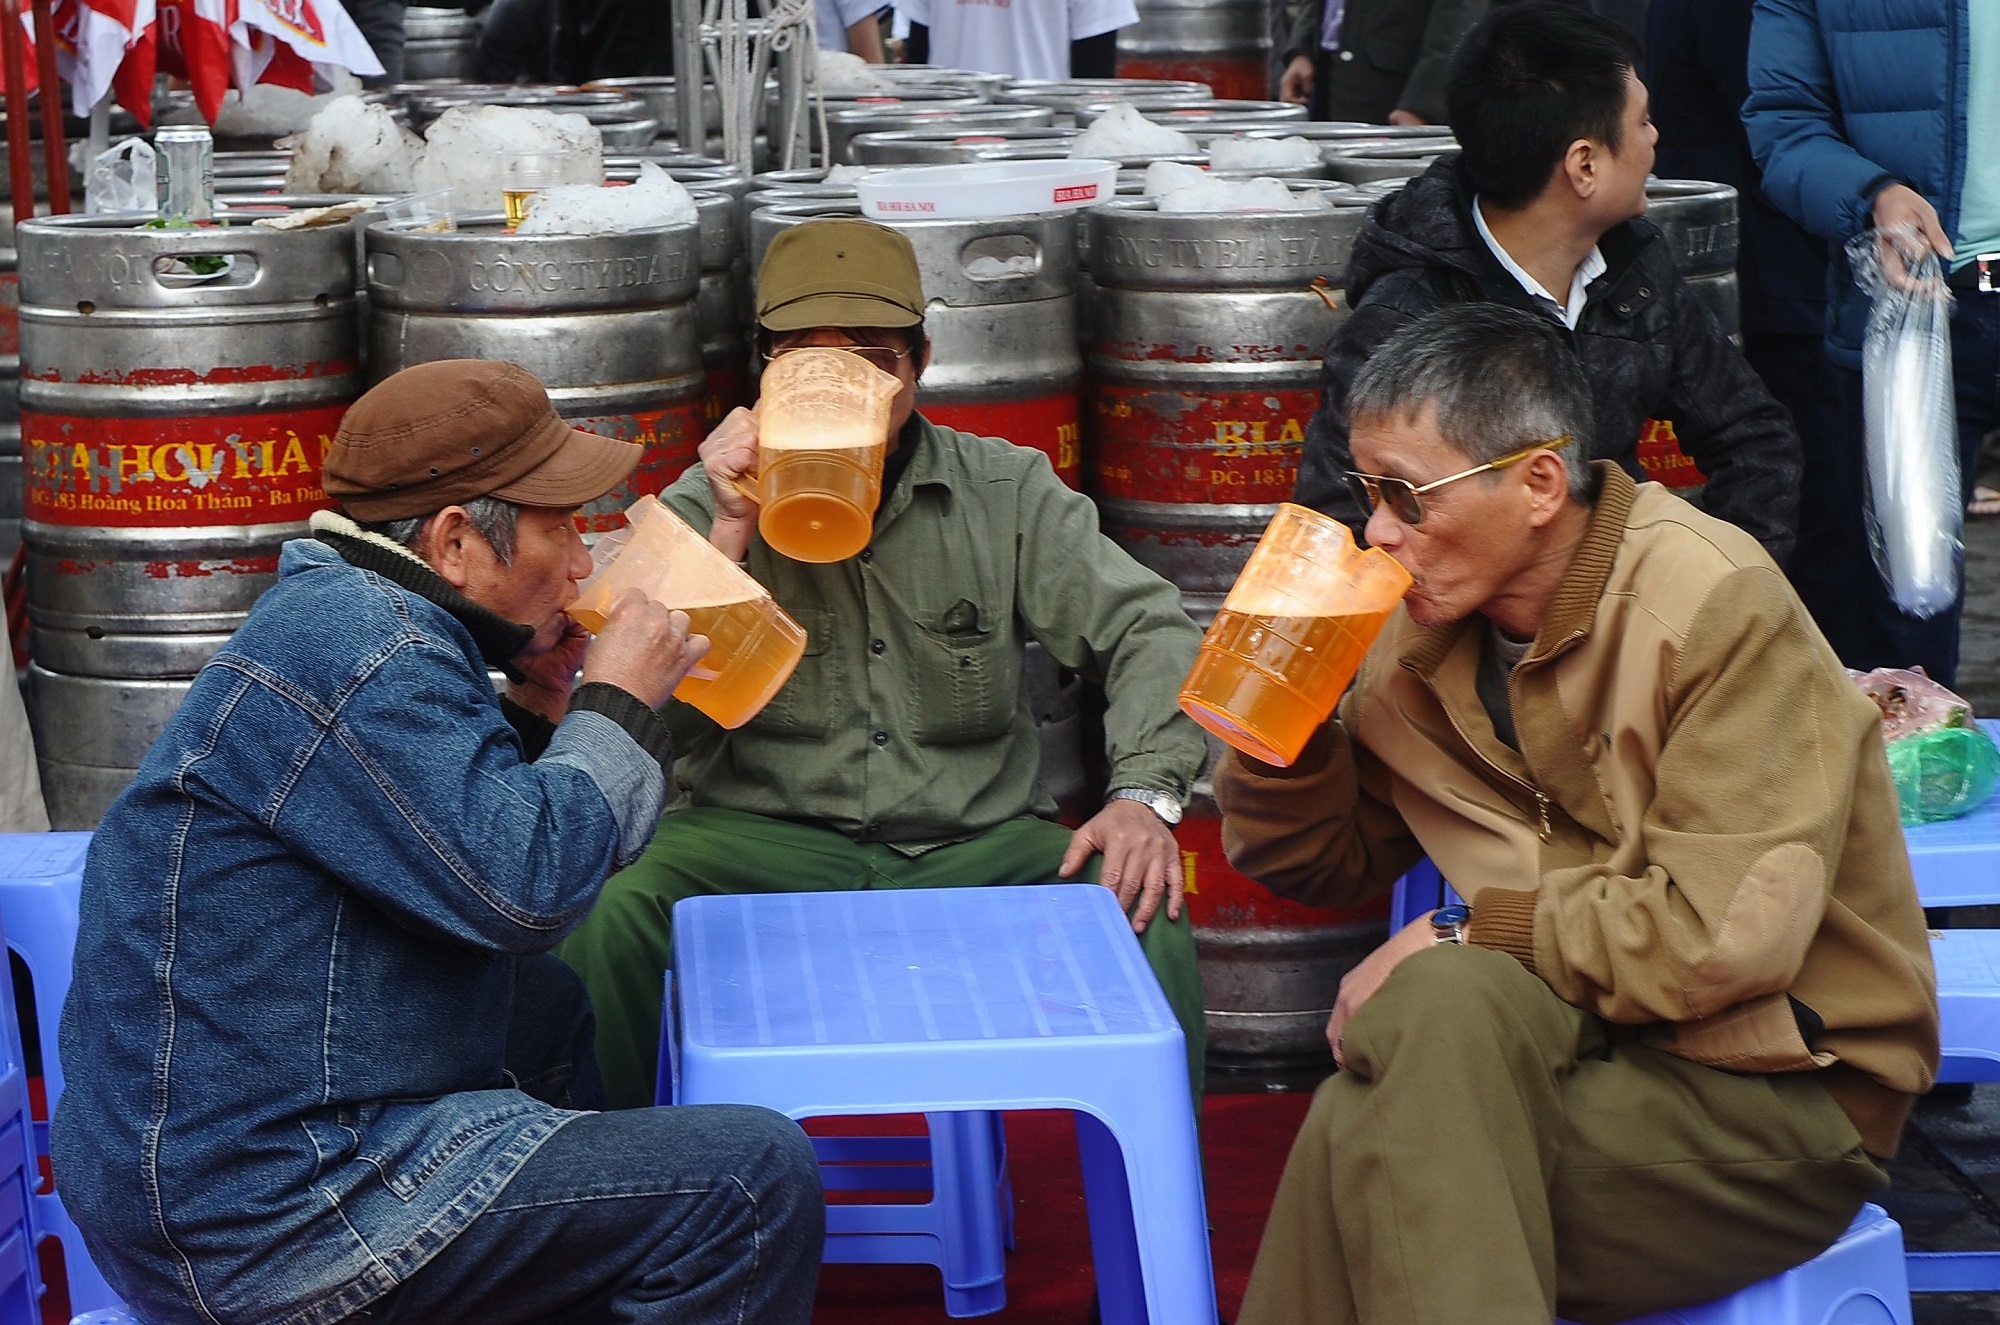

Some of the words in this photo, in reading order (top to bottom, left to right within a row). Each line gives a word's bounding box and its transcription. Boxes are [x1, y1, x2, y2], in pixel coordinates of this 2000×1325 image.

[1168, 238, 1211, 268] TY
[1214, 238, 1274, 268] BIA
[469, 253, 562, 292] CÔNG
[567, 259, 612, 291] TY
[616, 254, 663, 288] BIA
[1211, 418, 1304, 457] BIA
[1253, 468, 1287, 486] 183
[80, 494, 142, 516] Hoàng
[146, 494, 188, 512] Hoa
[270, 490, 292, 506] Ba
[297, 486, 329, 503] Đìn
